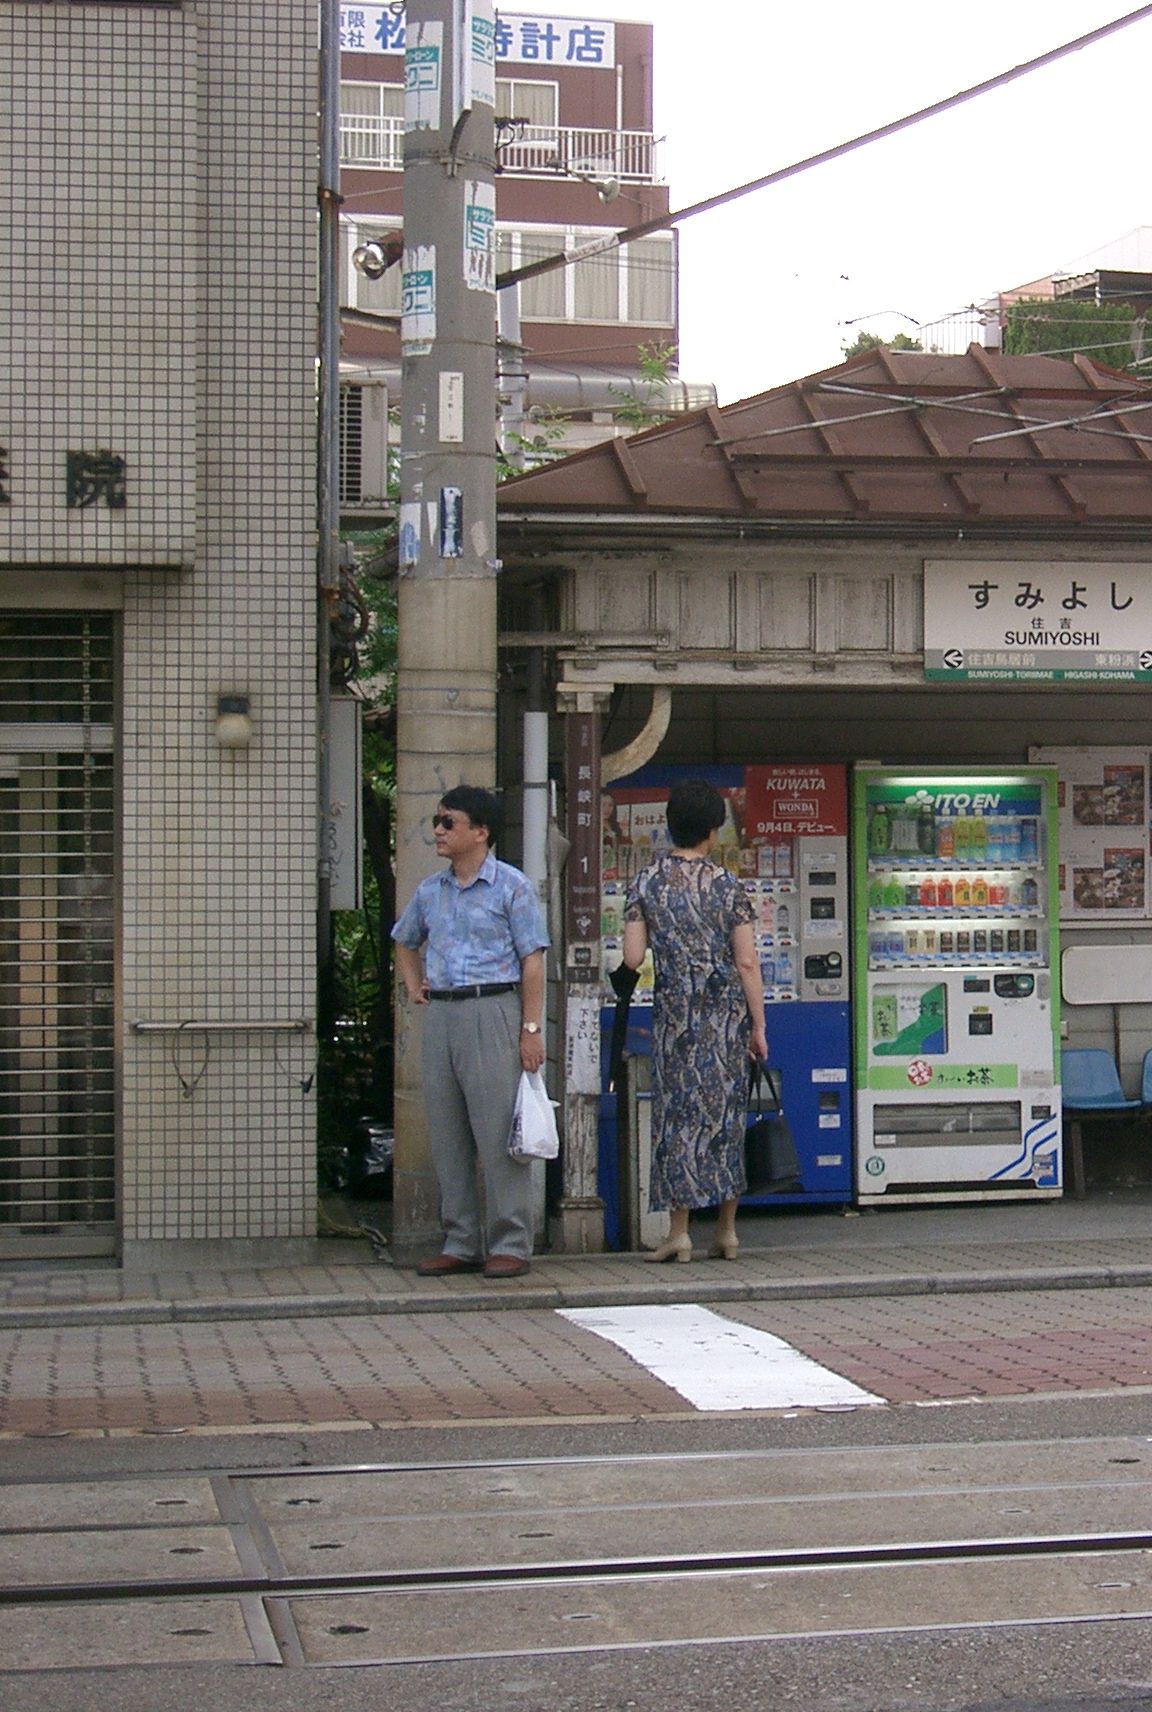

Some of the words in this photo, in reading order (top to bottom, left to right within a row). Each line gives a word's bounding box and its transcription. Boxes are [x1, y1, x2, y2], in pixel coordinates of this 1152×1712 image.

[405, 66, 433, 87] クニ
[402, 289, 428, 311] クニ
[968, 580, 1133, 611] すみよし
[1031, 616, 1072, 631] 住吉
[1004, 631, 1100, 646] SUMIYOSHI
[766, 778, 826, 790] KUWATA
[778, 803, 814, 813] WONDA
[935, 794, 970, 808] ITO
[972, 794, 1000, 808] EN
